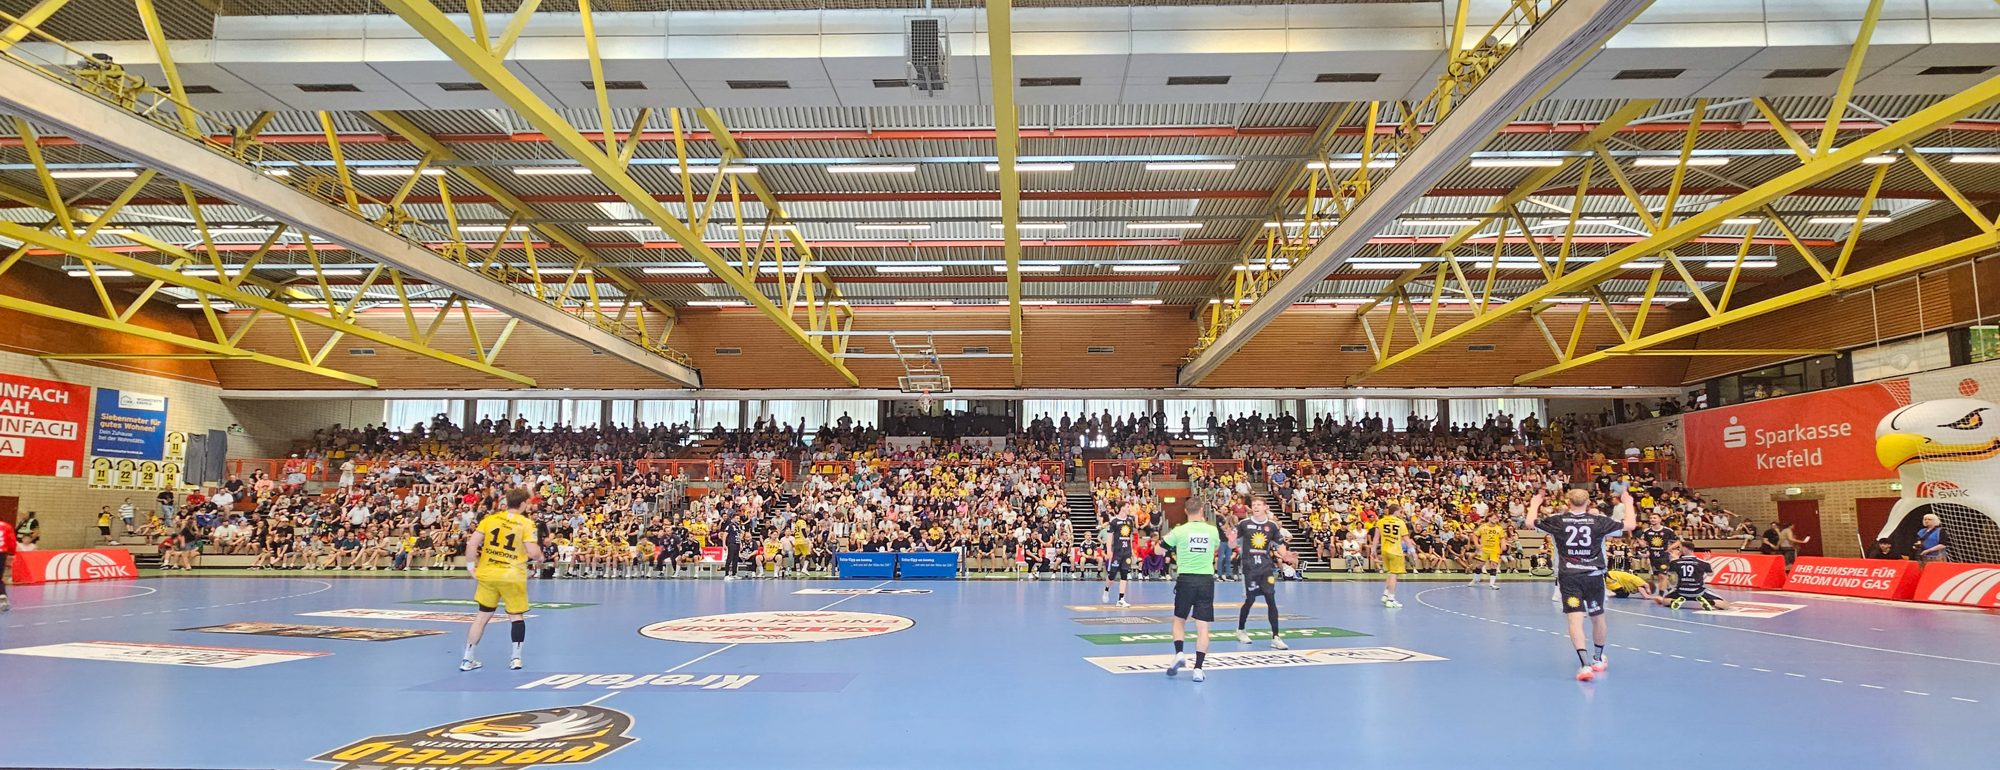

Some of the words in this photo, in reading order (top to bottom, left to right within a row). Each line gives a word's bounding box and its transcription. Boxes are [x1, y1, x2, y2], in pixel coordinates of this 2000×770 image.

[100, 421, 122, 429] gutes
[124, 423, 156, 432] Wohnen!
[101, 413, 149, 425] Siebenmeter
[150, 418, 161, 427] für
[1755, 422, 1852, 448] Sparkasse
[1756, 448, 1823, 470] Krefeld
[97, 470, 105, 478] 11
[120, 471, 131, 479] 22
[144, 472, 154, 480] 29
[166, 473, 174, 481] 14
[1938, 489, 1970, 499] SWK
[1383, 524, 1400, 536] 55
[1565, 526, 1592, 547] 23
[490, 528, 516, 551] 11
[86, 565, 131, 578] SWK
[1680, 565, 1695, 577] 19
[1795, 565, 1814, 574] IHR
[1814, 566, 1870, 578] HEIMSPIEL
[1871, 566, 1896, 578] FÜR
[1718, 572, 1757, 586] SWK
[1790, 574, 1831, 586] STROM
[1832, 577, 1861, 588] UND
[1862, 580, 1891, 590] GAS
[514, 674, 760, 689] Krefeld
[413, 740, 567, 750] NIEDERRHEIN
[331, 740, 610, 765] KREFELD
